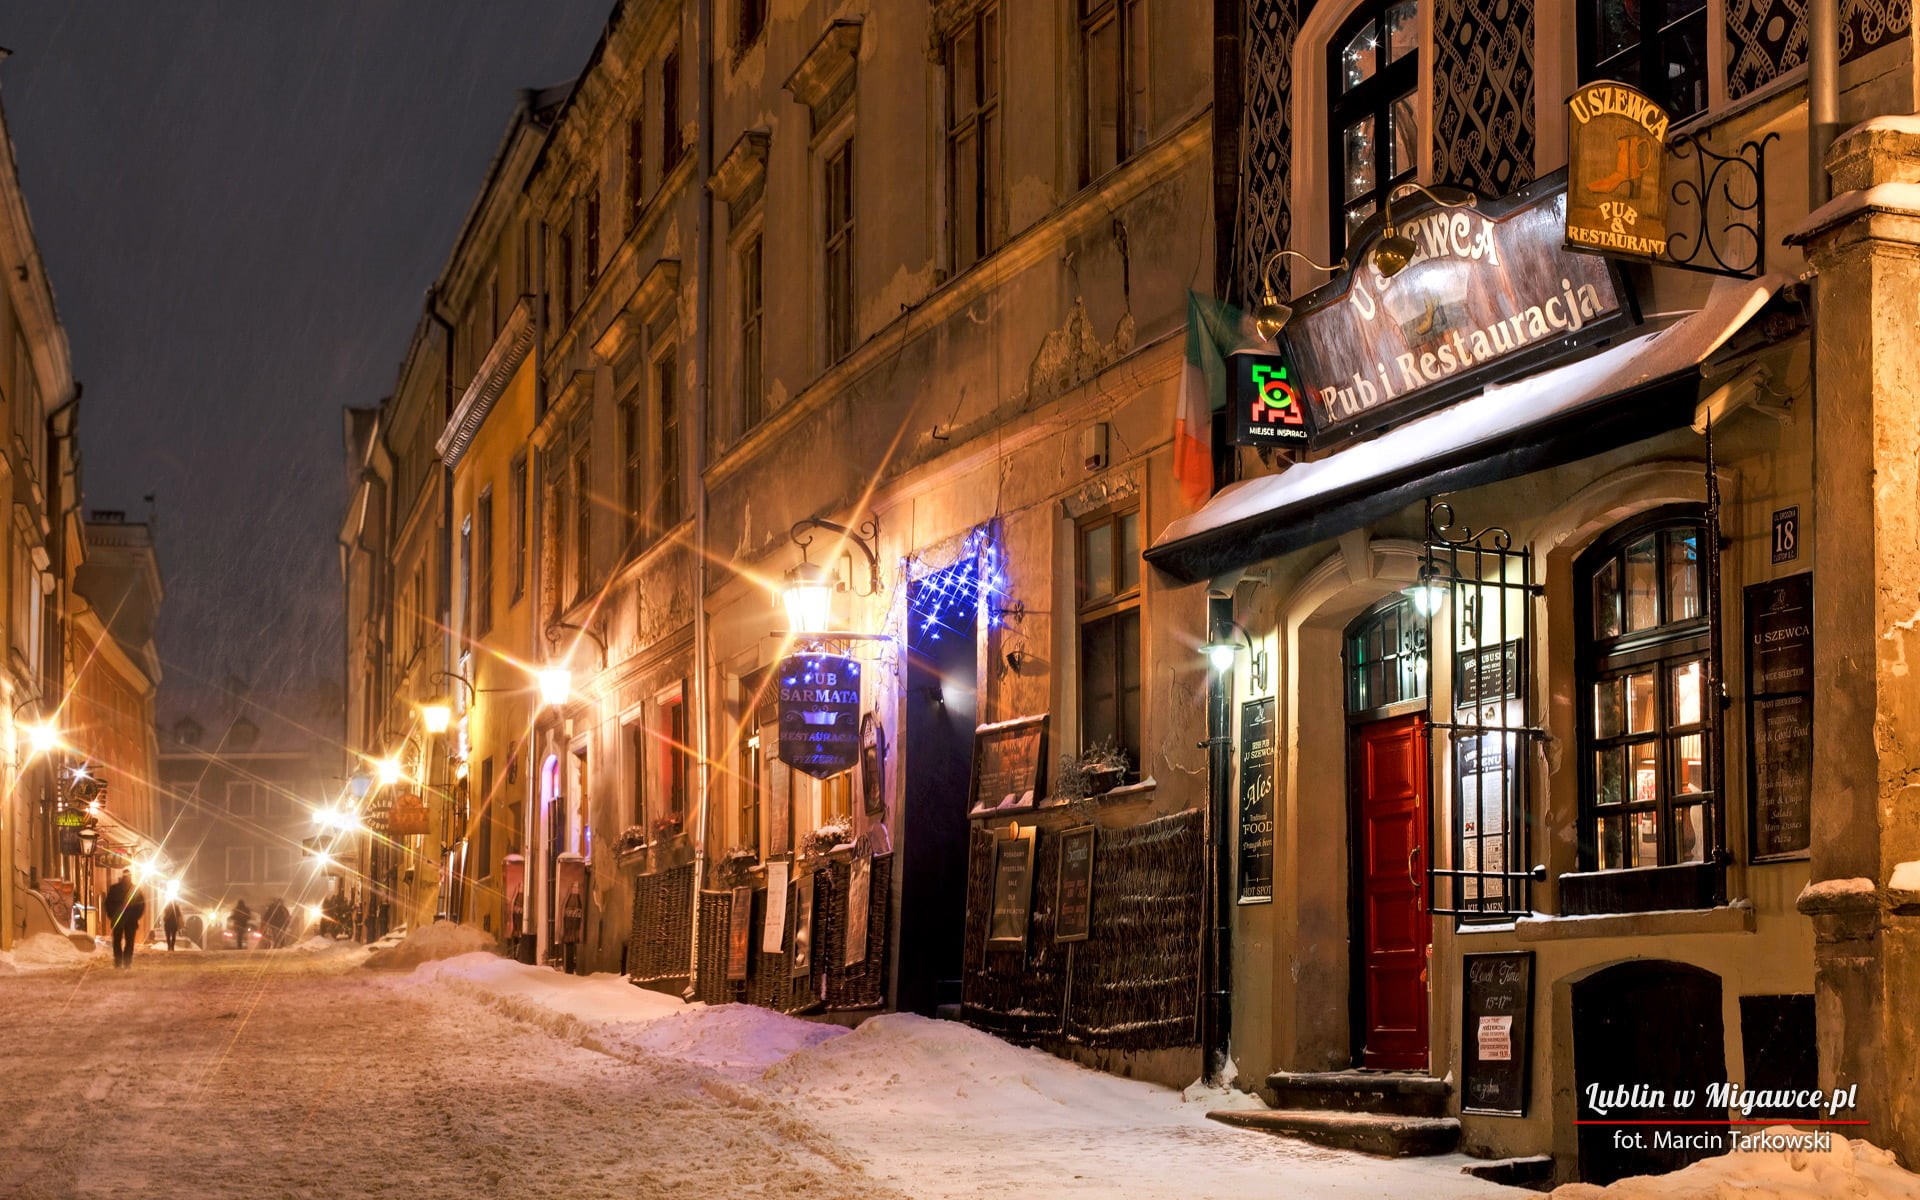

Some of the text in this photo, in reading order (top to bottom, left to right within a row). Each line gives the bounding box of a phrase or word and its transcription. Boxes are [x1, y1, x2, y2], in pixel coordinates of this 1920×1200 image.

[1569, 87, 1670, 144] U SZEWCA
[1599, 200, 1638, 226] PUB
[1610, 216, 1627, 235] &
[1568, 225, 1667, 255] RESTAURANT
[1349, 276, 1376, 321] U
[1318, 277, 1604, 423] Pub i Restauracja
[1249, 426, 1275, 436] MIEJSCE
[1775, 520, 1794, 552] 18
[1754, 625, 1810, 645] U SZEWCA
[780, 689, 859, 704] SARMATA
[1250, 747, 1274, 760] SZEWCA
[1244, 774, 1272, 811] Ales
[1242, 820, 1273, 835] FOOD
[1243, 885, 1272, 897] HOT SPOT
[1486, 901, 1503, 911] MEN
